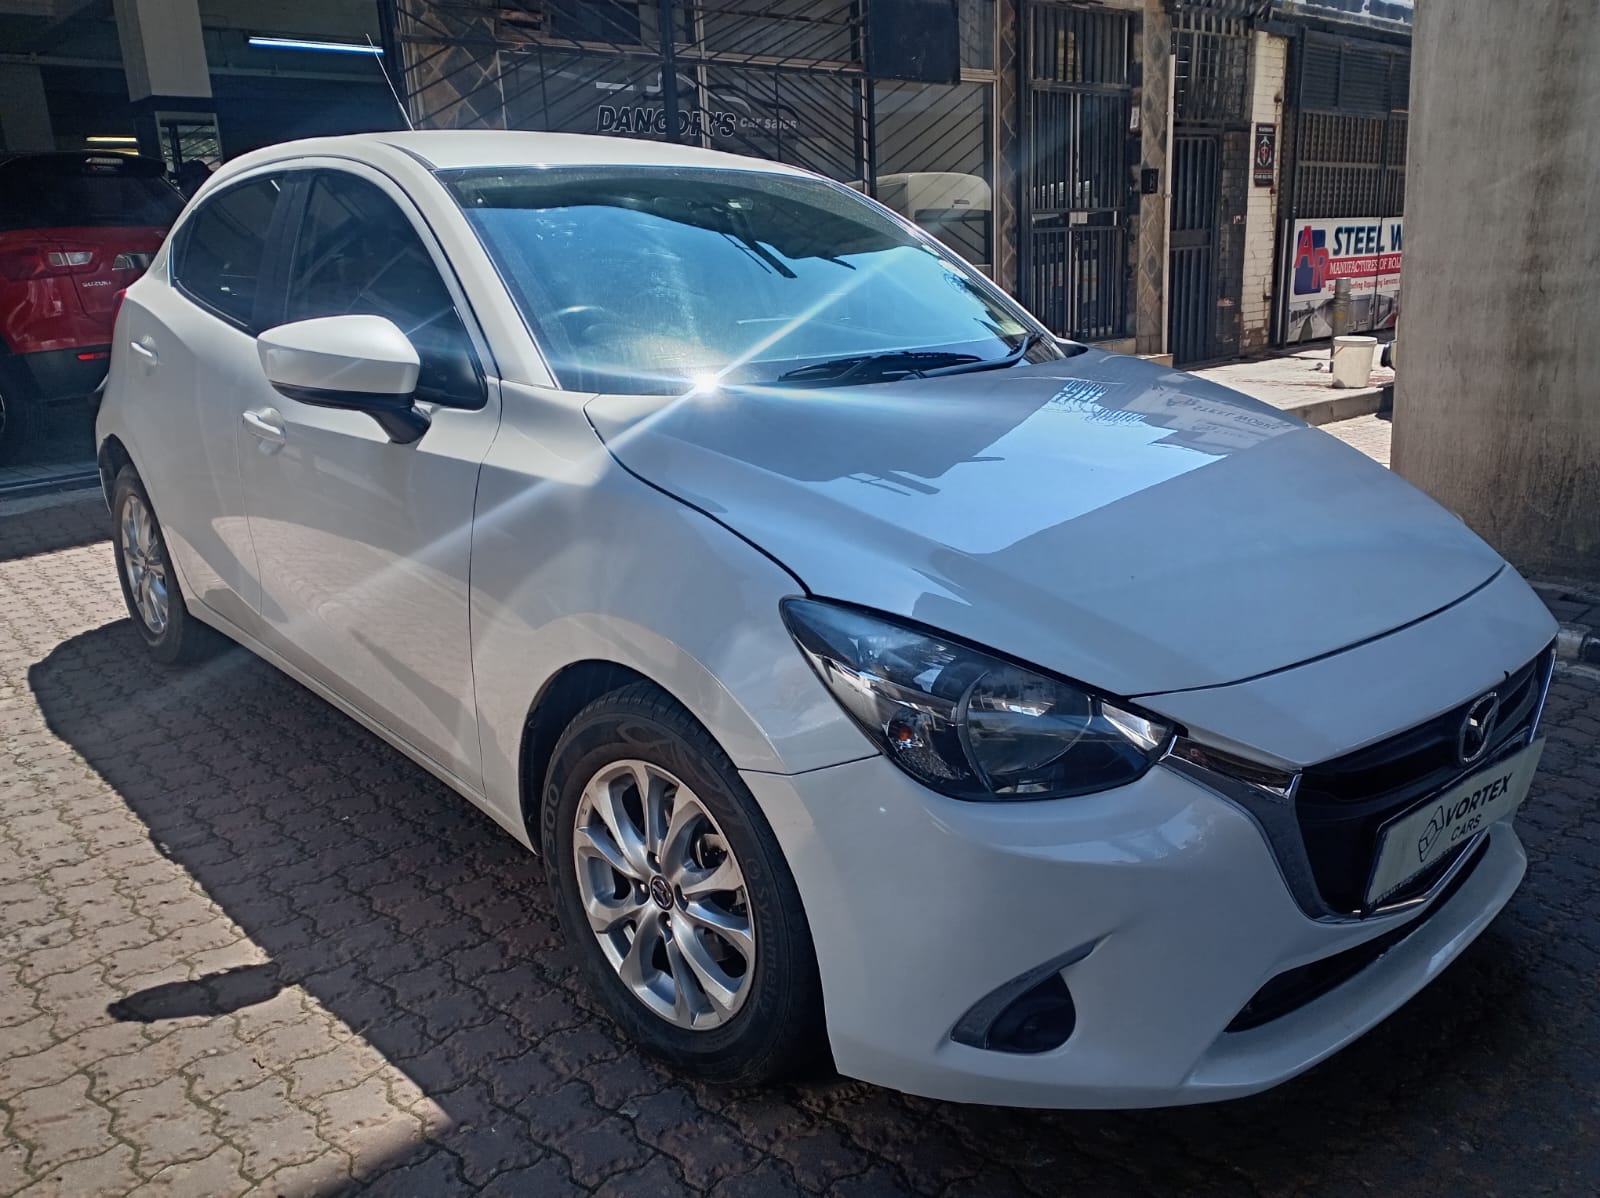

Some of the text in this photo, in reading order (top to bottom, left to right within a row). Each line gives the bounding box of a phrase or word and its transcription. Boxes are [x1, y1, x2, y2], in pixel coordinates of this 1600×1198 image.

[1332, 226, 1385, 256] STEEL
[1379, 258, 1387, 270] OF
[1444, 772, 1513, 828] VORTEX
[1450, 814, 1482, 841] CARS
